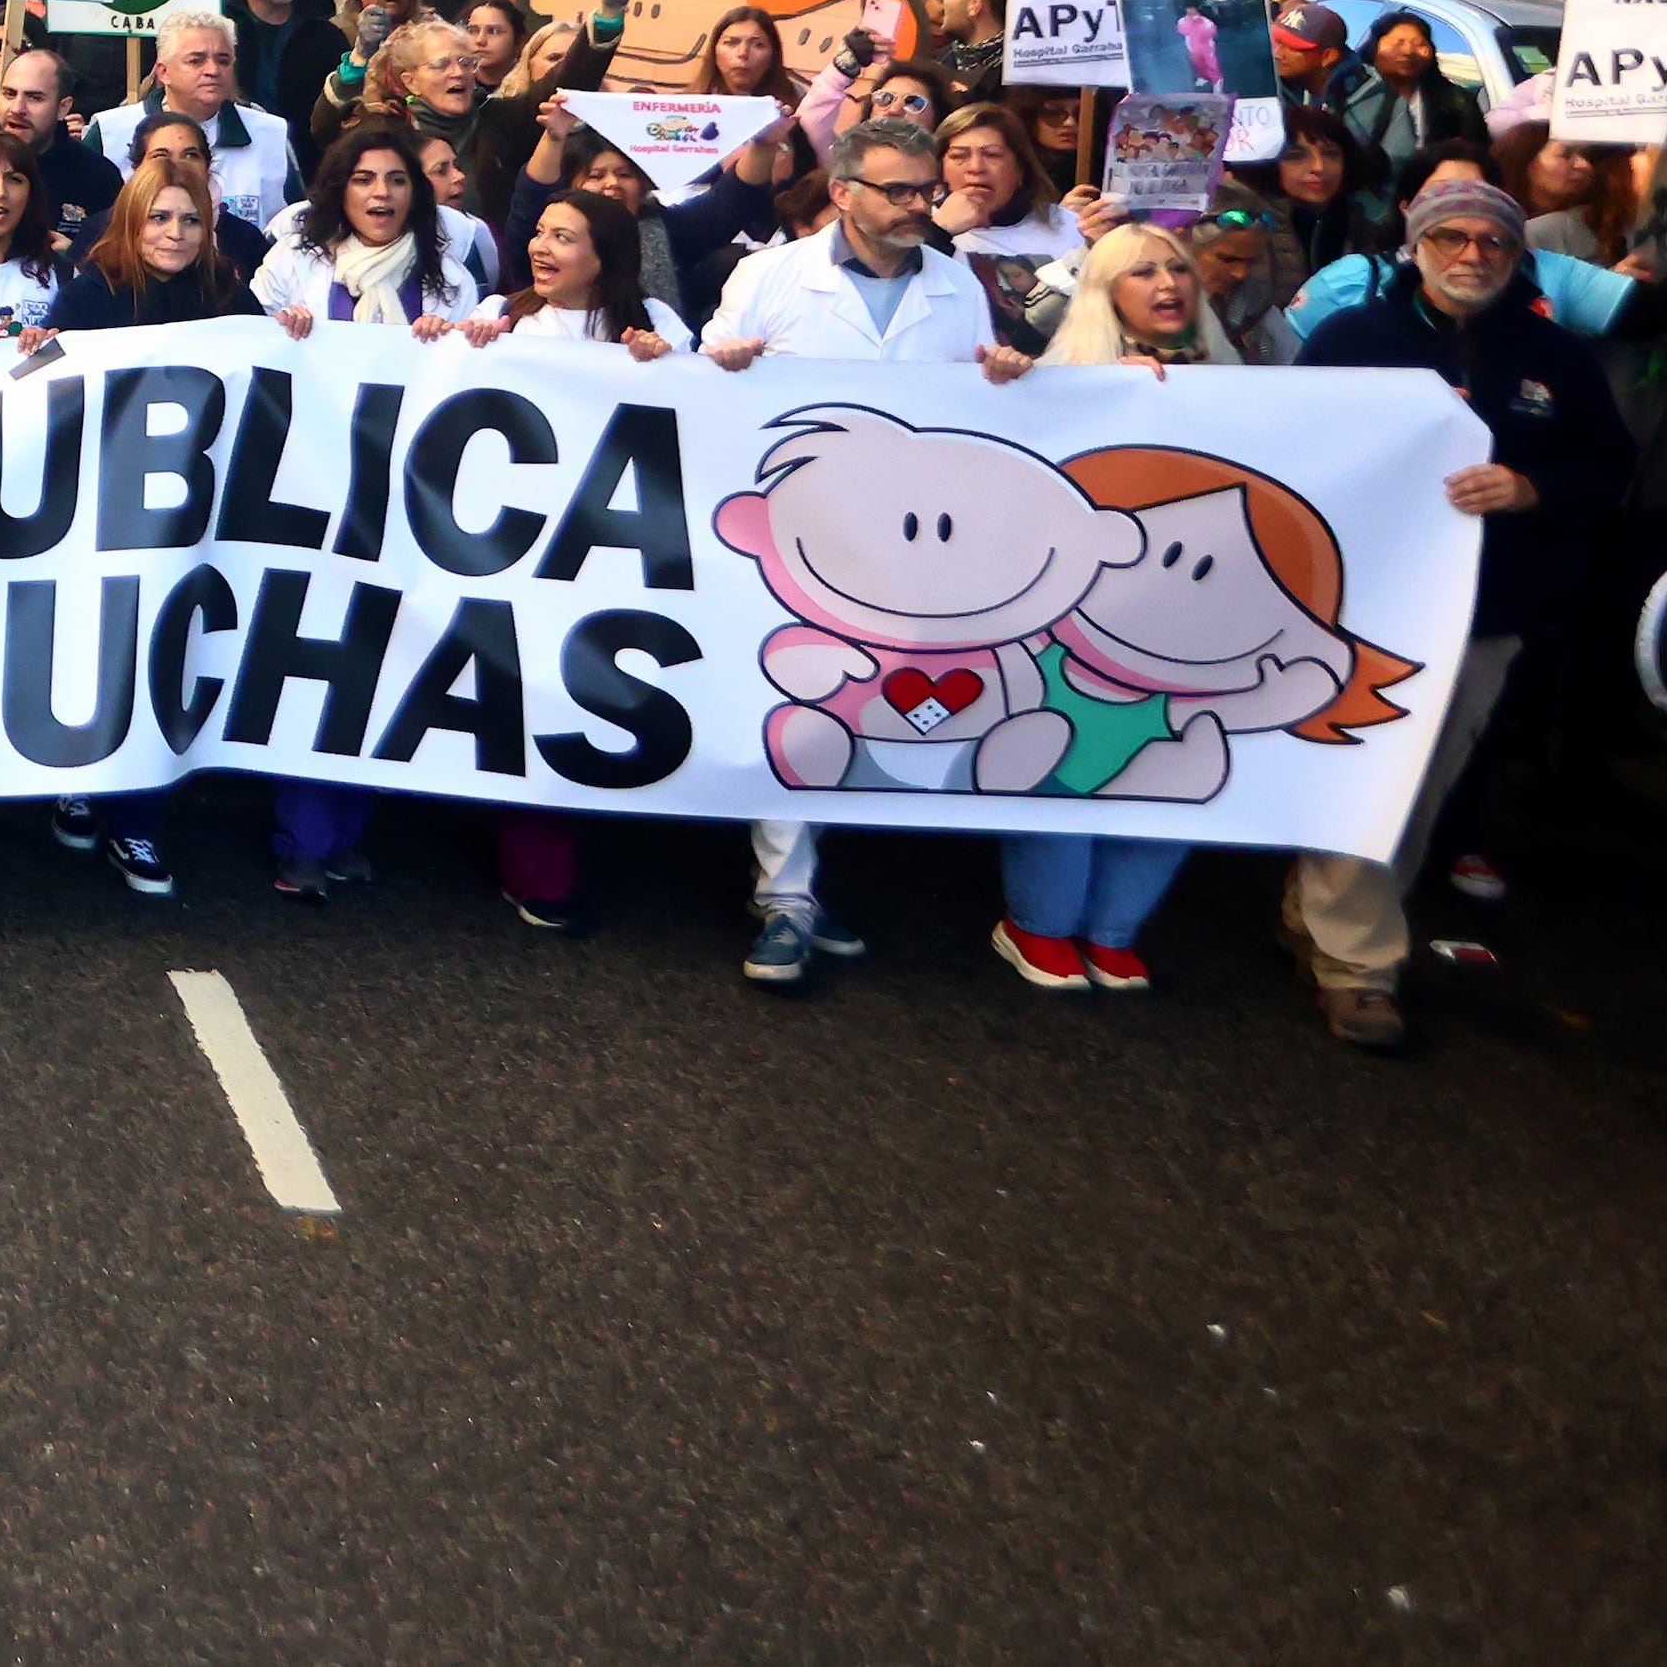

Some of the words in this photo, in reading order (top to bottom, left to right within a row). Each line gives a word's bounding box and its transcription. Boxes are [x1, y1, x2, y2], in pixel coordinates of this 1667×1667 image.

[110, 15, 156, 31] CABA
[1013, 44, 1069, 59] Hospital
[1071, 41, 1124, 56] Garraha
[632, 100, 722, 115] ENFERMERÍA
